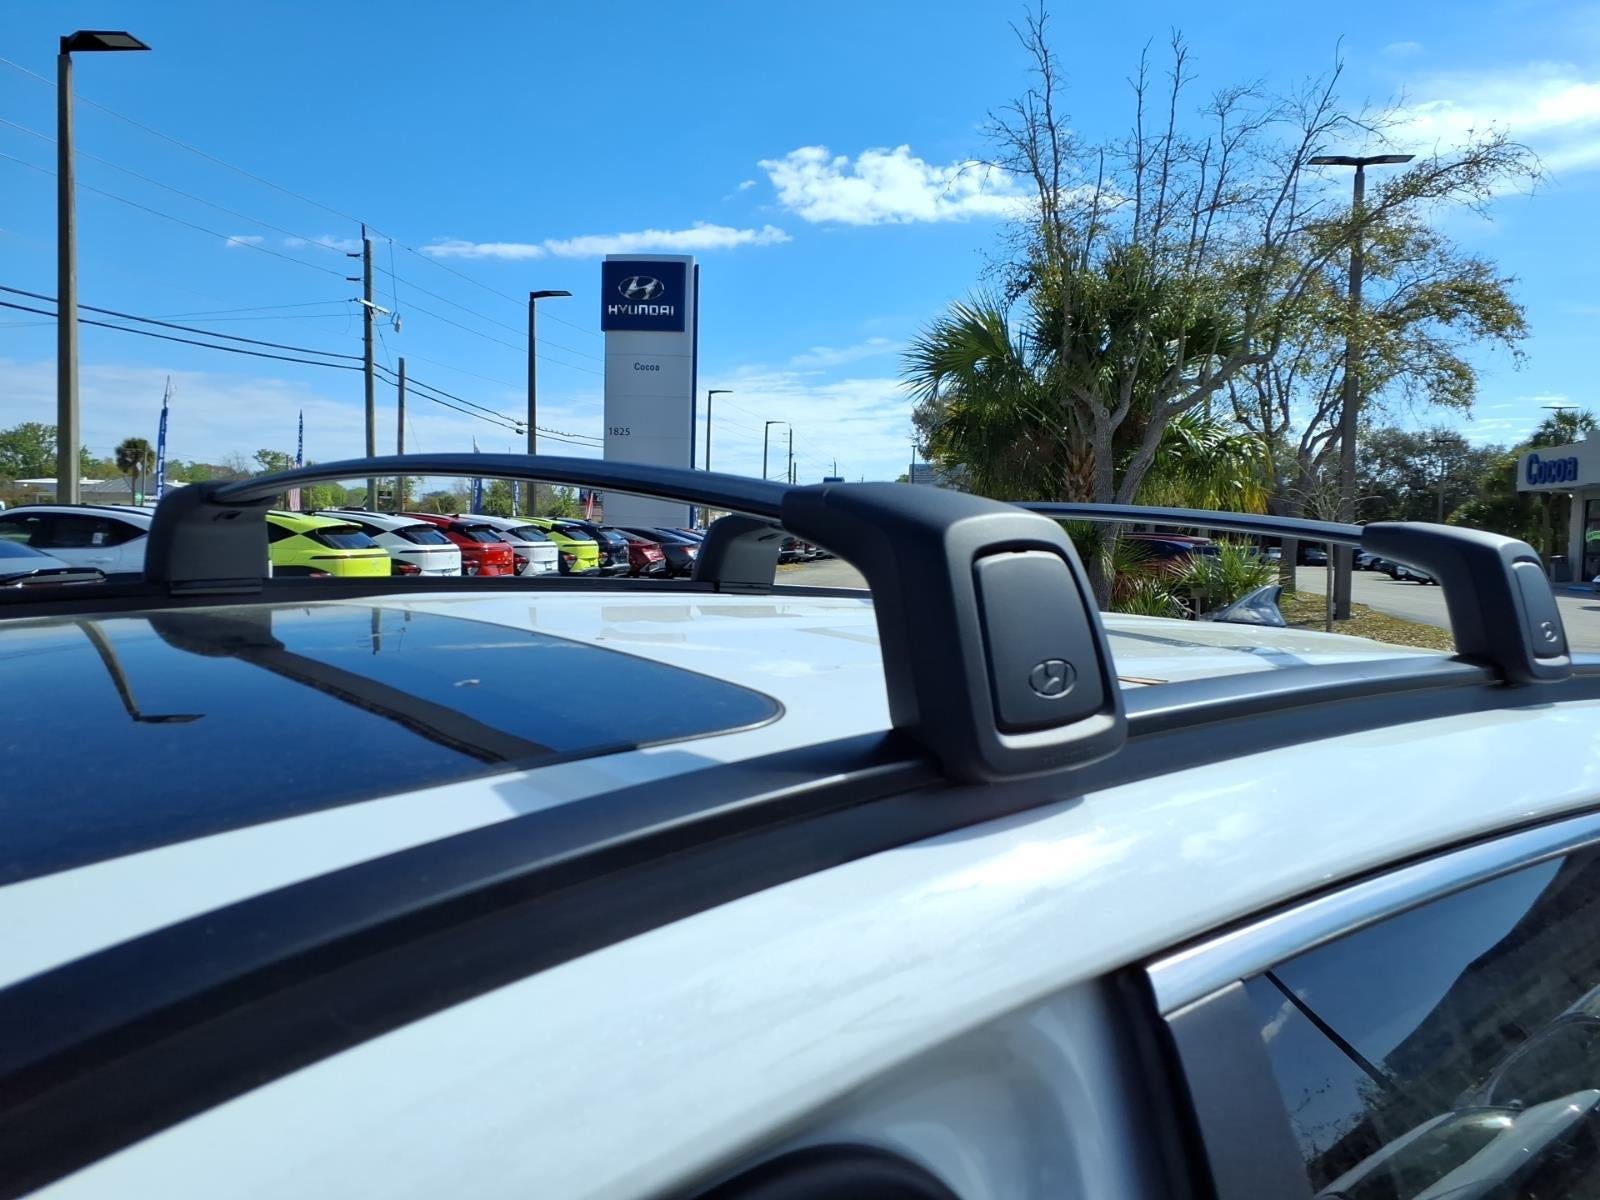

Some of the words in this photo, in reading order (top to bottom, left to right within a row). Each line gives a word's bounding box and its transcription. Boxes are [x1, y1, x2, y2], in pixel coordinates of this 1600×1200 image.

[608, 304, 674, 316] HYUNDAI
[634, 362, 660, 372] Cocoa
[608, 427, 631, 436] 1825
[1526, 453, 1578, 485] Cocoa
